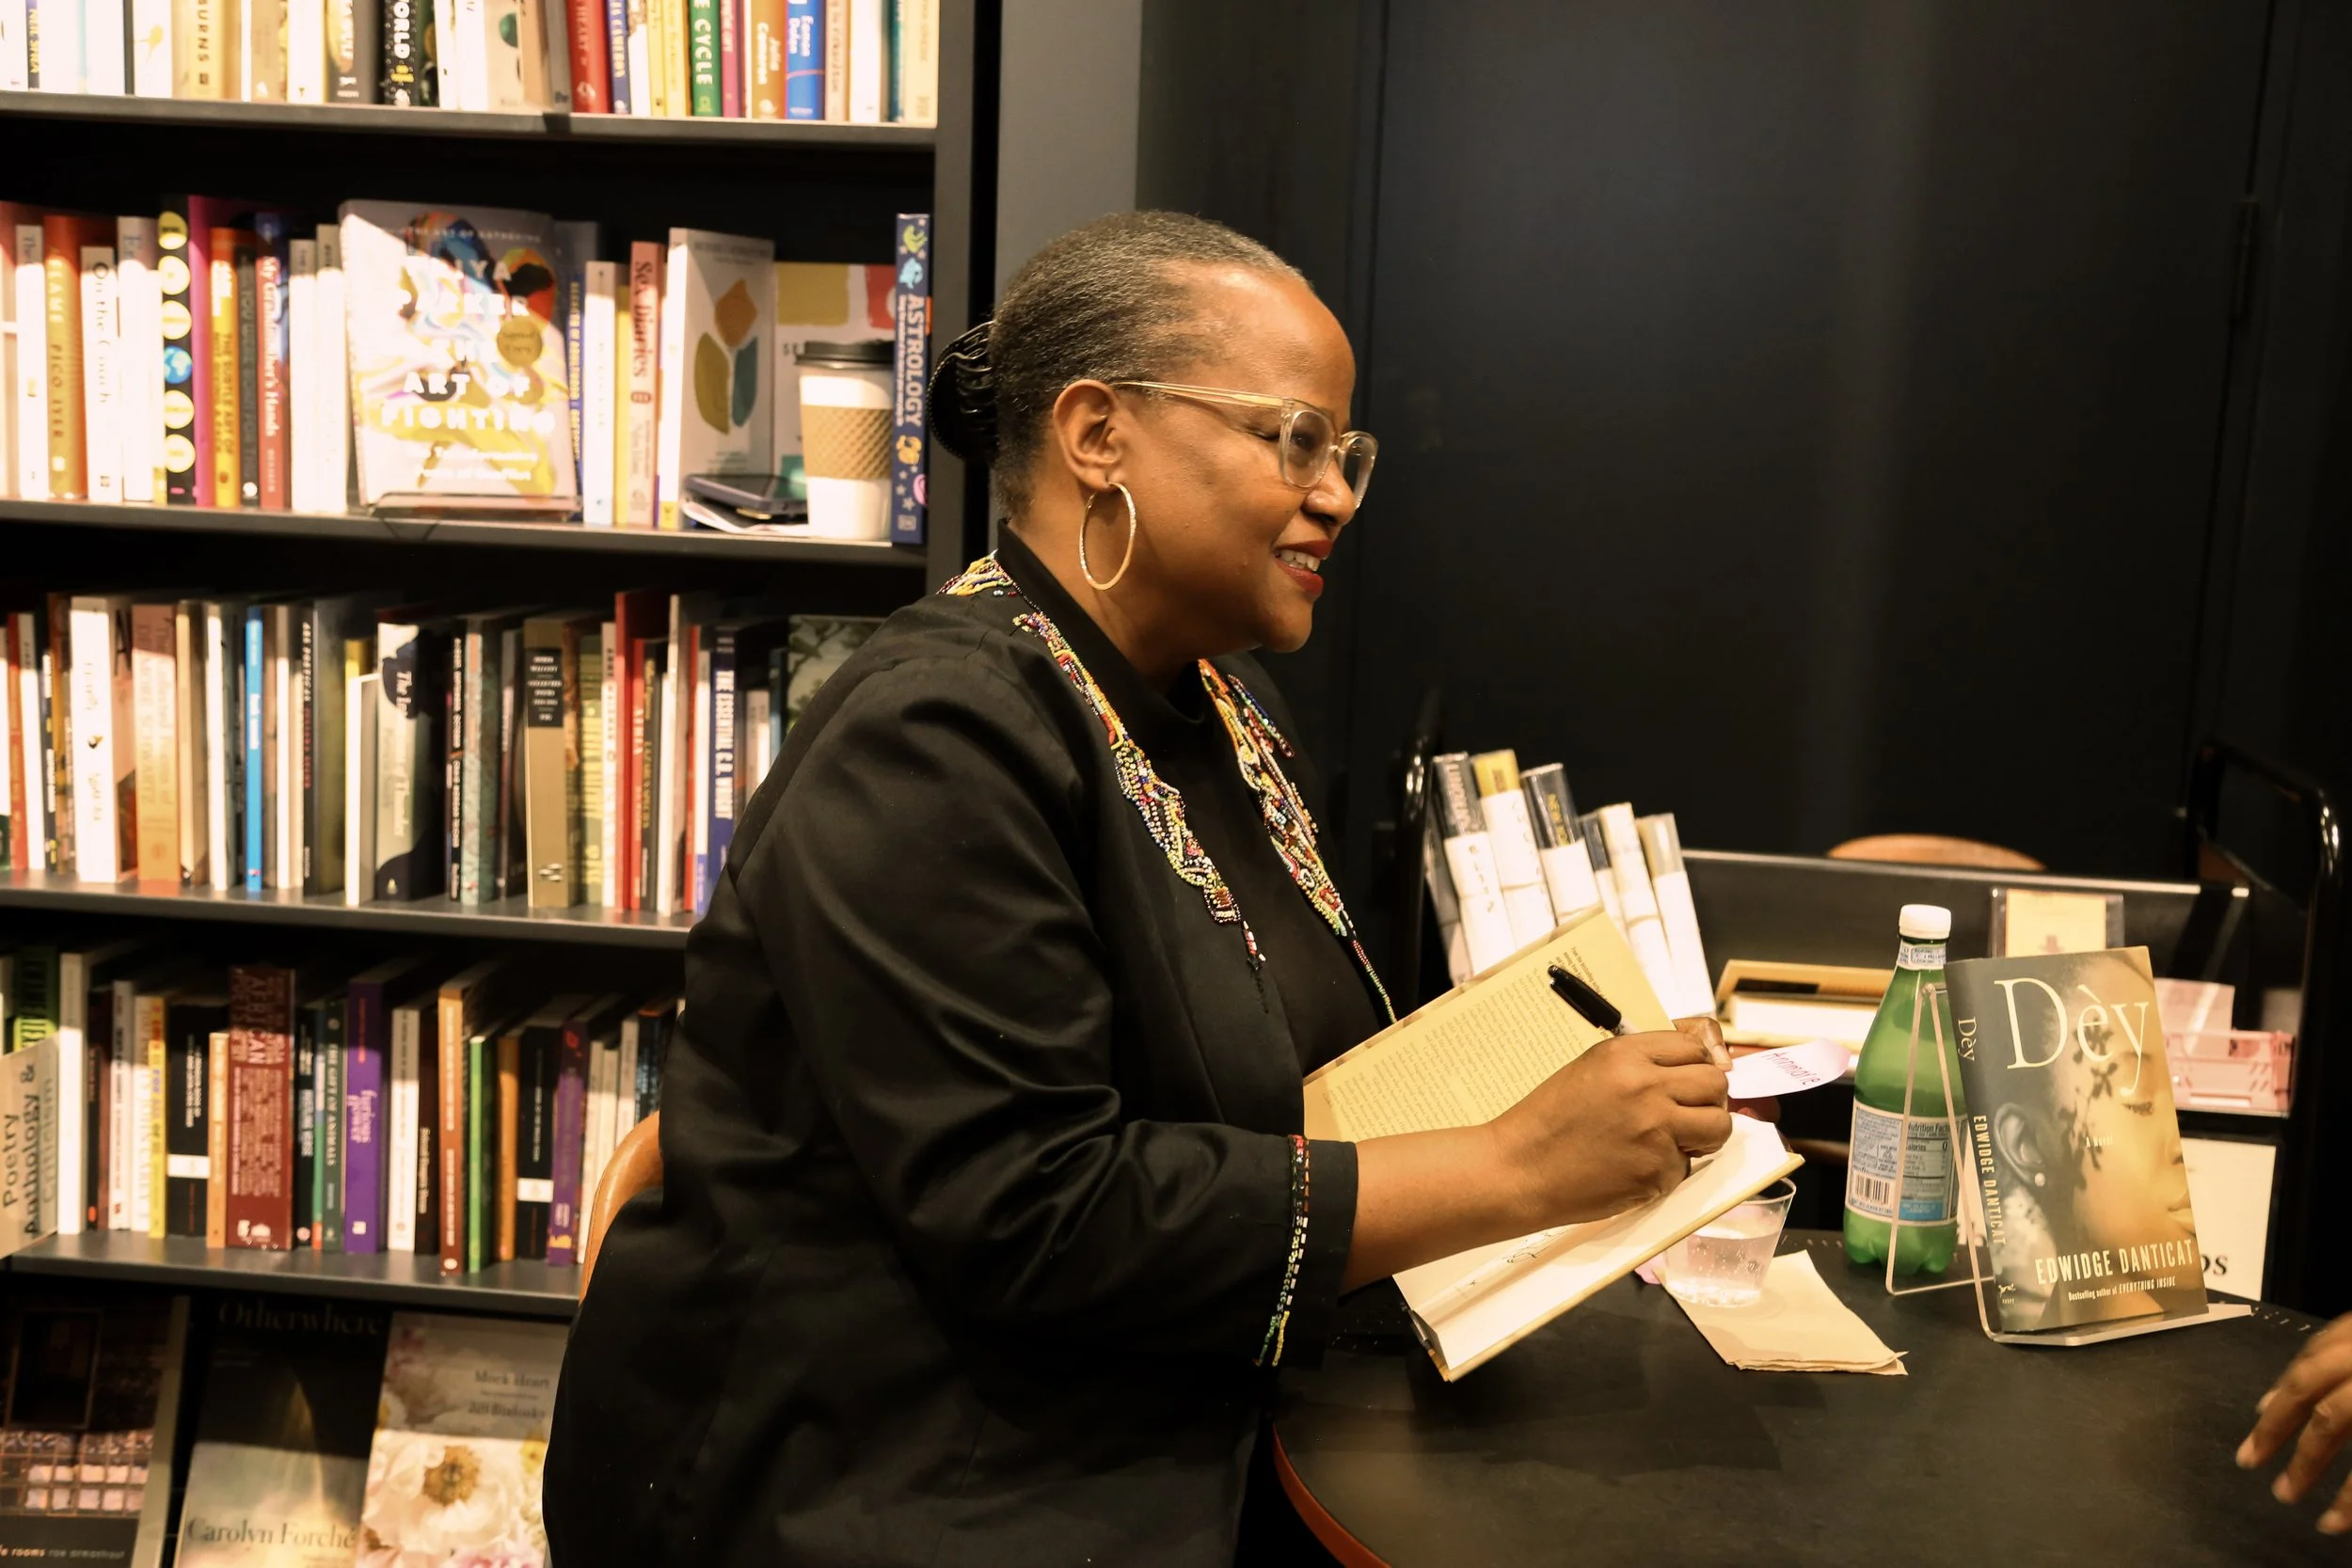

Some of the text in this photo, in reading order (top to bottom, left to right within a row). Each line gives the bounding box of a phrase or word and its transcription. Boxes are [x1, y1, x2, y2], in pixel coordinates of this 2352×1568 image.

[393, 0, 410, 58] ORLD
[694, 19, 713, 85] CYCLE
[633, 305, 656, 379] Diaries
[906, 293, 926, 427] ASTROLOGY
[51, 344, 65, 388] PICO
[263, 391, 279, 436] Hands
[716, 671, 735, 691] THE
[716, 693, 734, 751] ESSENTIAL
[1579, 961, 1595, 982] bestselling
[327, 1043, 339, 1065] THE
[1958, 1017, 1978, 1062] Dèy
[1994, 977, 2150, 1097] Dèy
[21, 1064, 37, 1084] &
[327, 1068, 339, 1092] GIFT
[3, 1114, 20, 1208] Poetry
[326, 1114, 339, 1166] ANIMALS
[1906, 1140, 1948, 1152] alories 0
[2086, 1136, 2091, 1148] A
[23, 1094, 40, 1239] Anthology
[1973, 1116, 2006, 1246] EDWIDGE DANTICAT
[2035, 1239, 2194, 1286] EDWIDGE DANTICAT
[2068, 1288, 2096, 1302] Bestselling
[2096, 1288, 2111, 1299] author
[2119, 1278, 2154, 1295] EVERYTHING
[2156, 1275, 2176, 1290] INSIDE
[11, 1548, 45, 1558] rooms
[188, 1517, 357, 1550] Carolyn Forché
